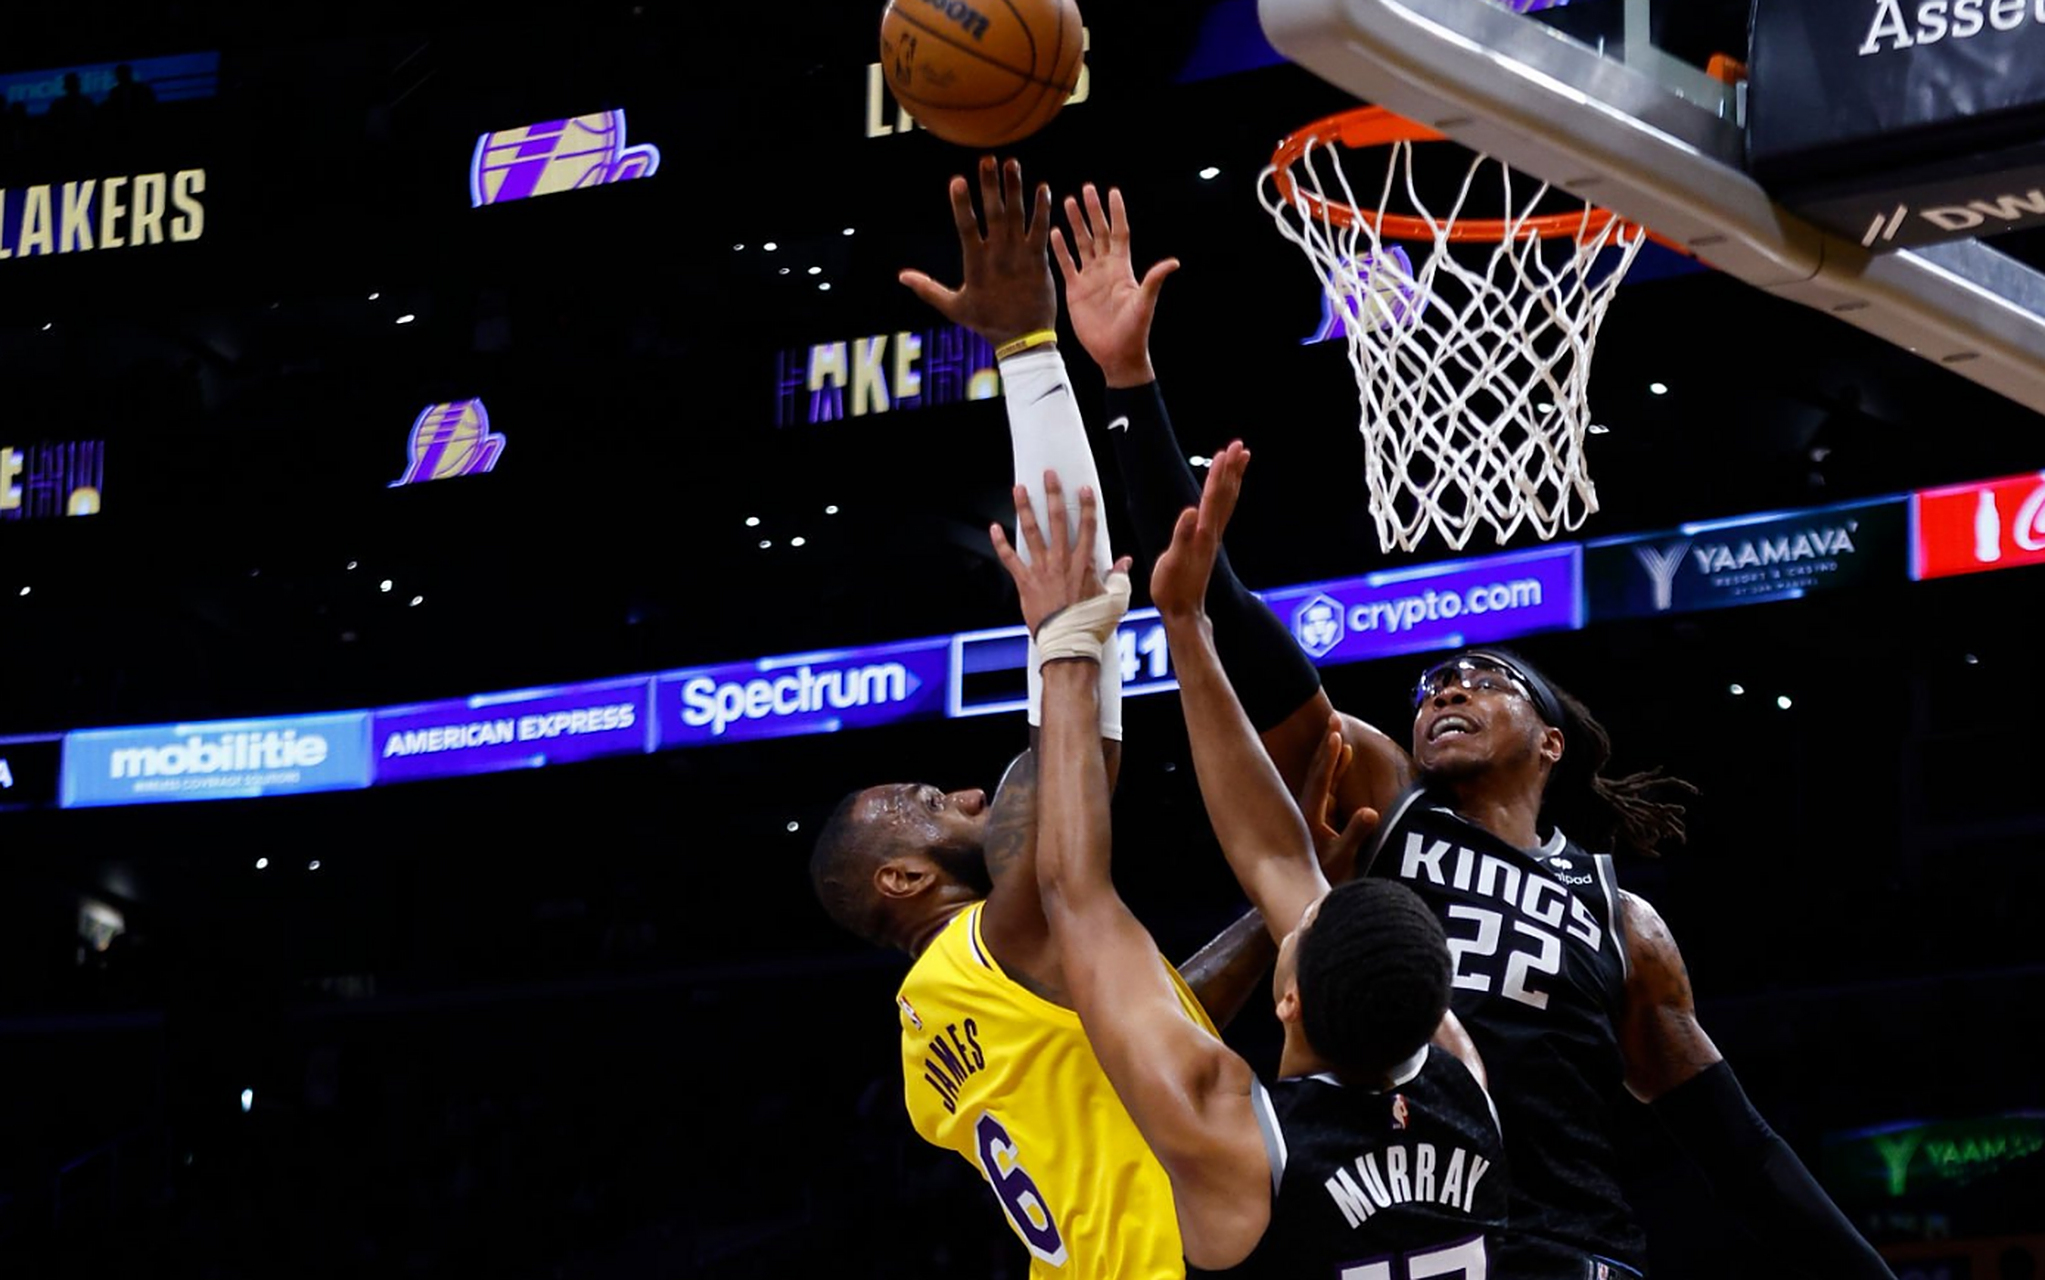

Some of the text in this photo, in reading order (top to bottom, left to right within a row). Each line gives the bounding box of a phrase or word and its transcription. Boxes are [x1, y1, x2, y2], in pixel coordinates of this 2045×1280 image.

[1348, 578, 1543, 633] crypto.com
[383, 702, 635, 758] AMERICAN EXPRESS
[682, 662, 906, 736] Spectrum
[110, 729, 328, 780] mobilitie
[1401, 831, 1602, 952] KINGS
[1447, 904, 1561, 1010] 22
[924, 1018, 985, 1115] JAMES
[974, 1109, 1069, 1268] 6
[1325, 1142, 1490, 1230] MURRAY
